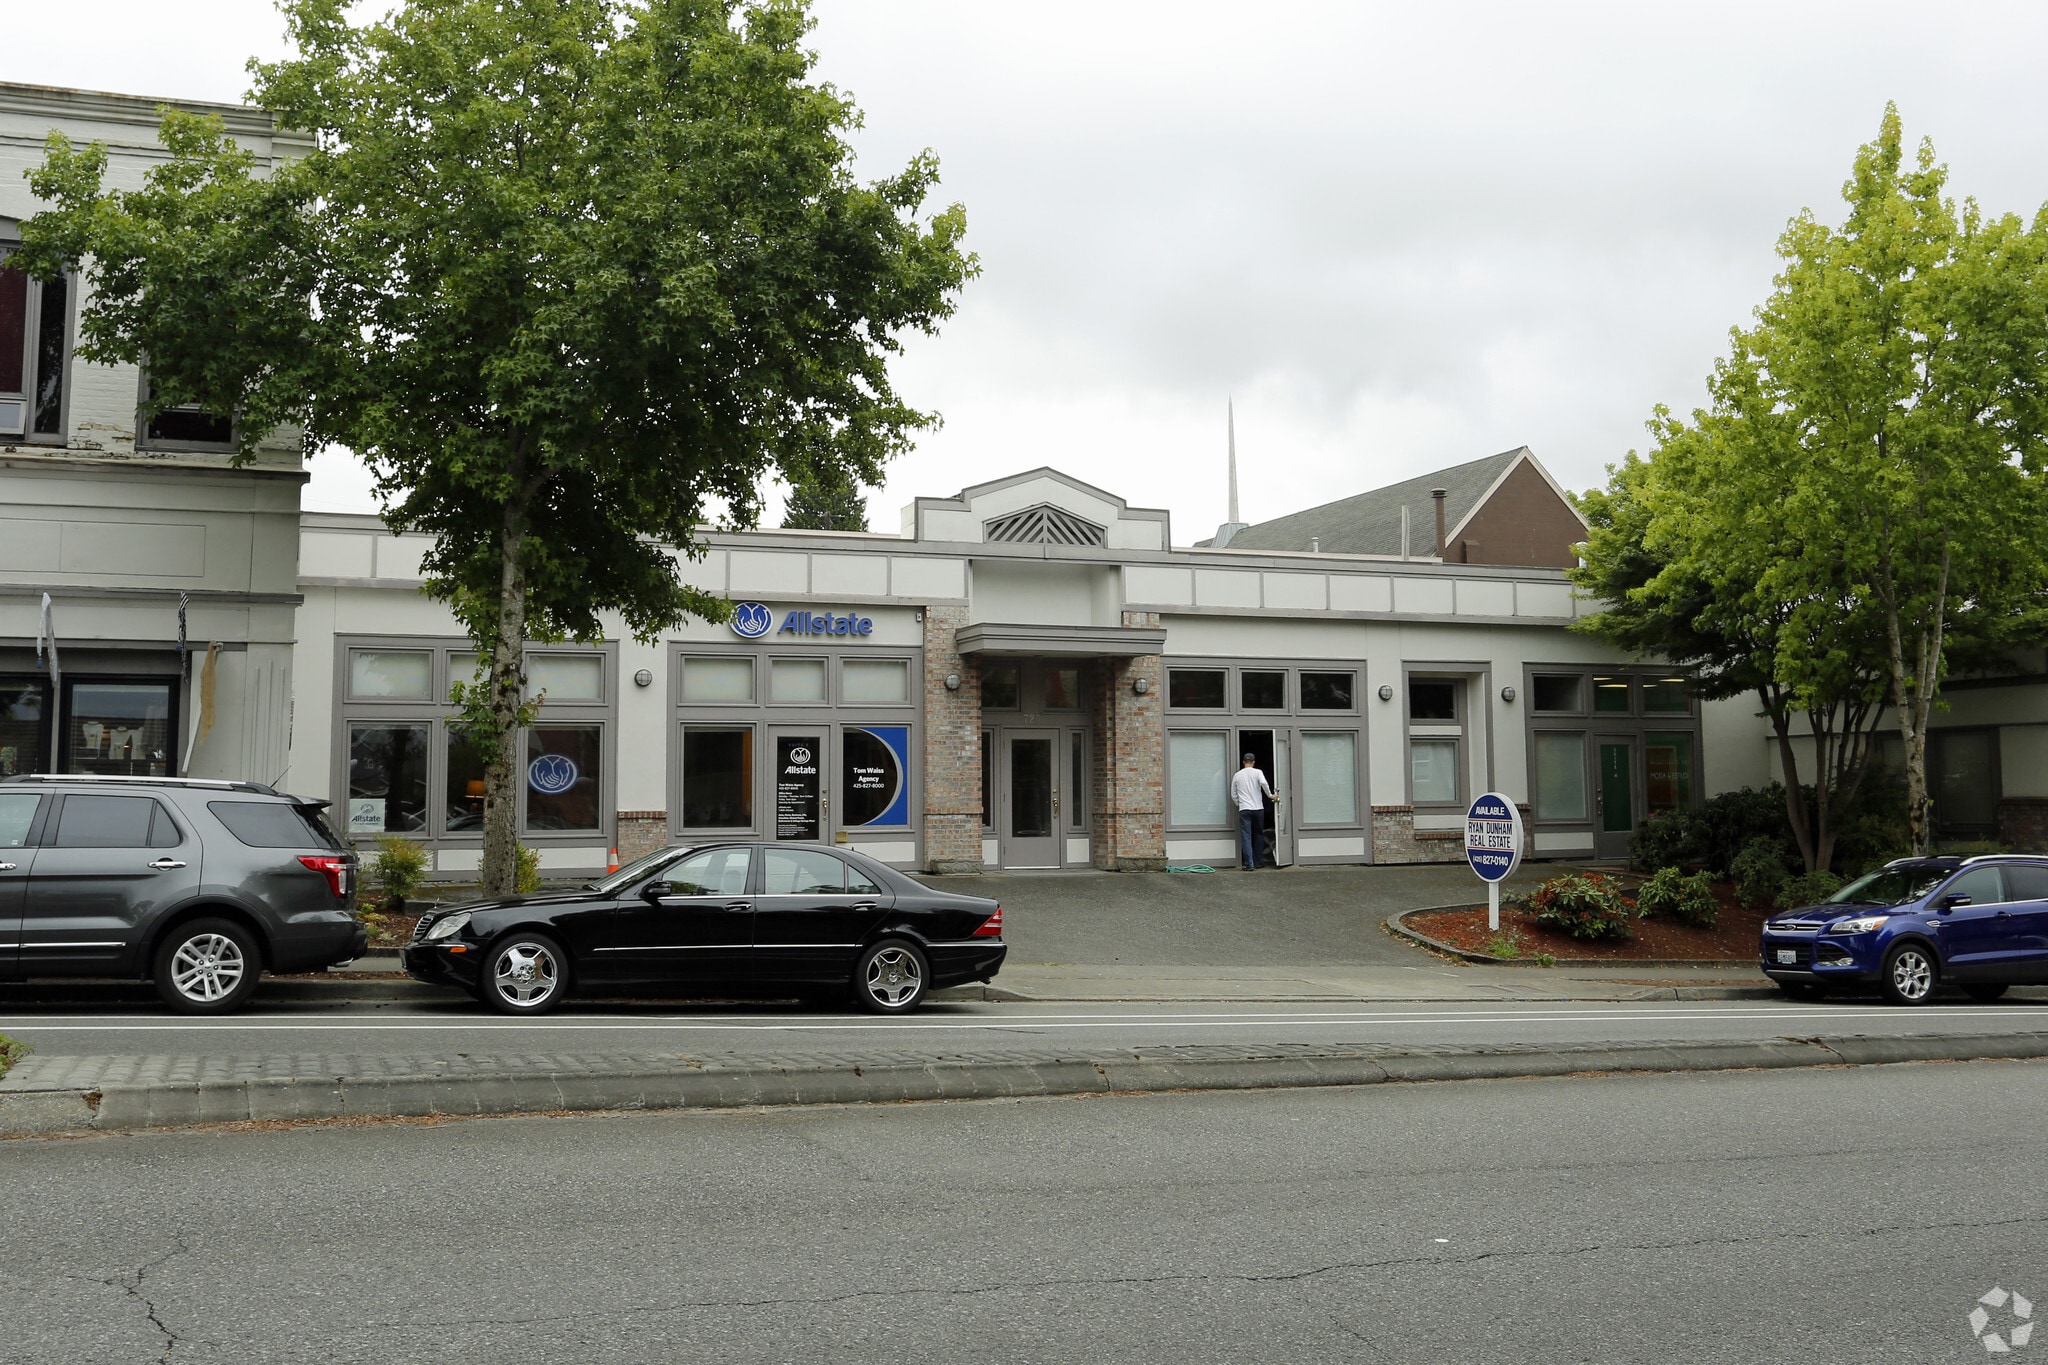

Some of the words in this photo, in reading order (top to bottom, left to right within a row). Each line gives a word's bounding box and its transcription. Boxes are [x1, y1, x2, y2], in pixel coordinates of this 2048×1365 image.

[778, 610, 873, 636] Allstate
[784, 765, 817, 775] Allstate
[858, 775, 880, 783] Agency
[1475, 806, 1505, 816] AVAILABLE
[1468, 821, 1484, 834] RYAN
[1486, 822, 1513, 835] DUNHAM
[1470, 834, 1486, 847] REAL
[1488, 835, 1511, 848] ESTATE
[1482, 855, 1509, 866] 827-0140
